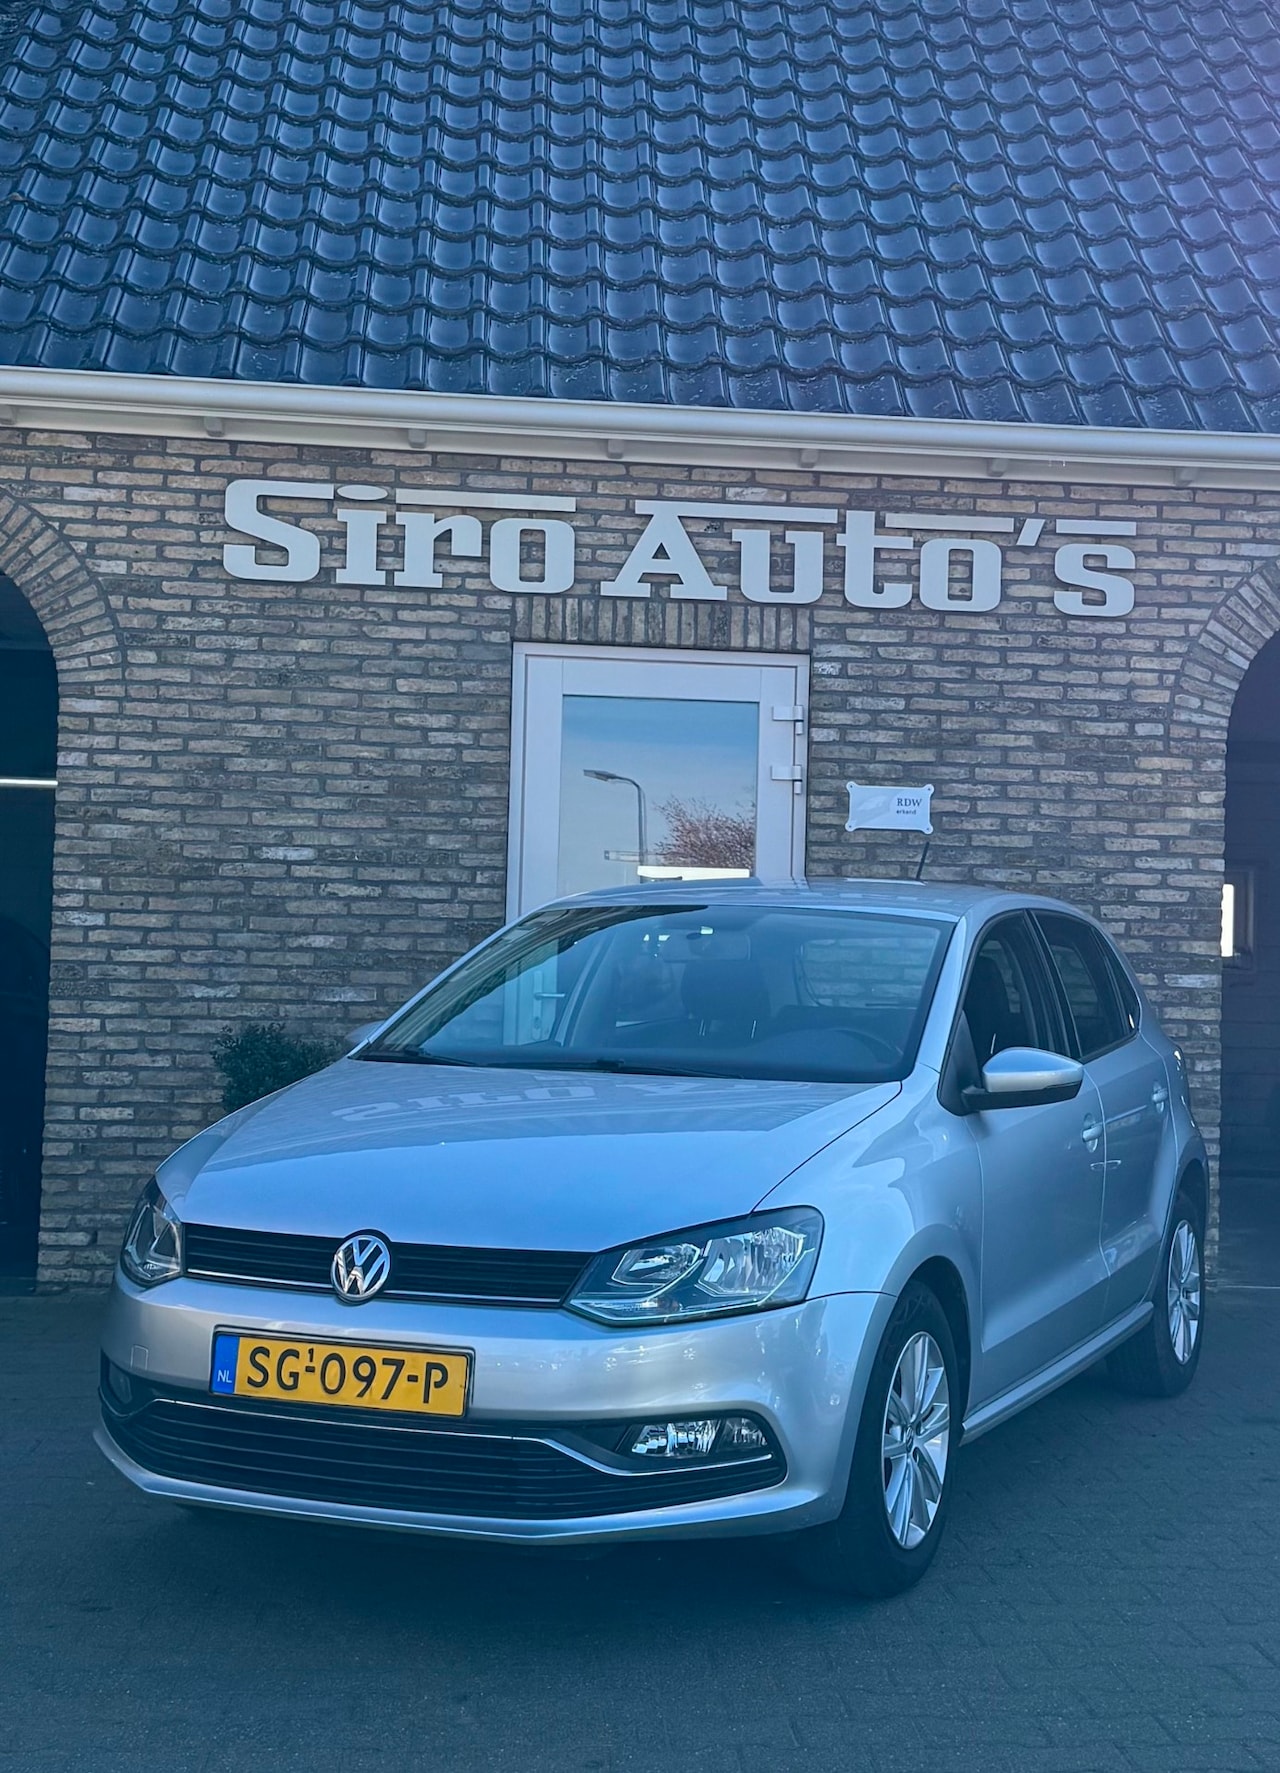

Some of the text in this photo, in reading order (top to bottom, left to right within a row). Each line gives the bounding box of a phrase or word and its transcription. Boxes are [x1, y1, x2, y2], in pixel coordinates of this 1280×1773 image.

[223, 479, 1136, 617] Siro Auto's
[896, 797, 922, 807] RDW
[217, 1369, 232, 1383] NL
[247, 1346, 449, 1404] SG-097-P
